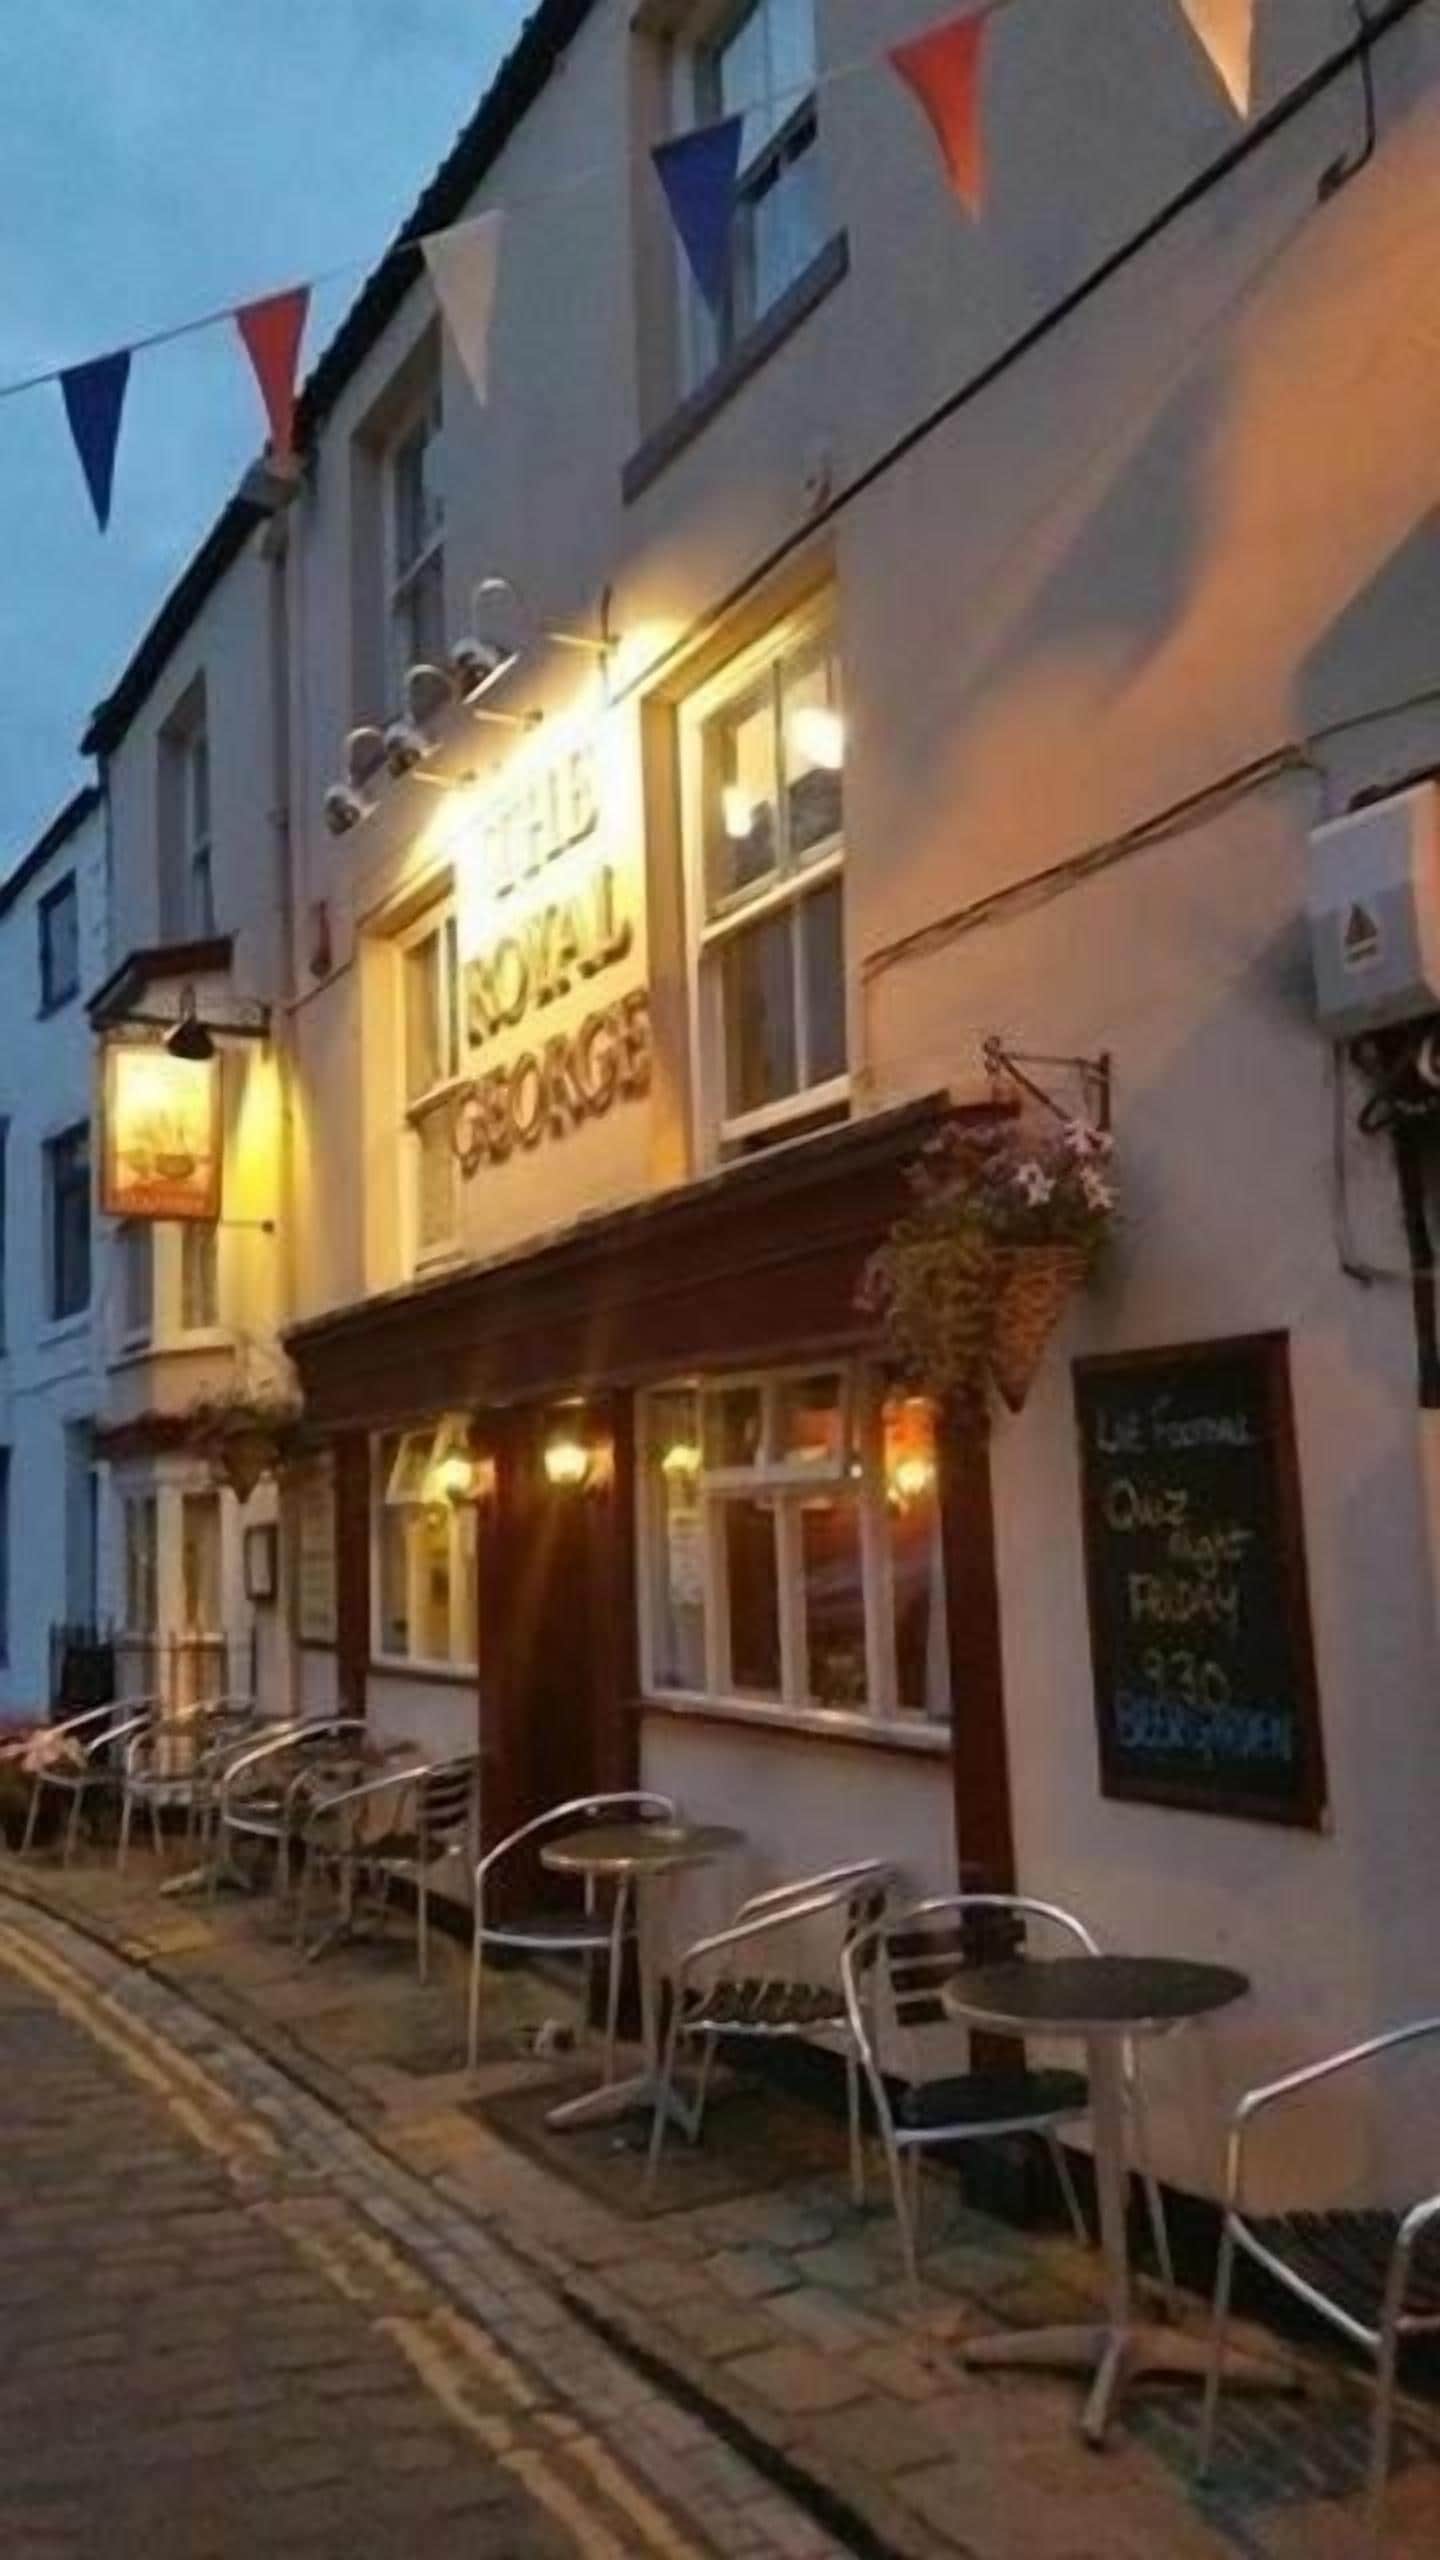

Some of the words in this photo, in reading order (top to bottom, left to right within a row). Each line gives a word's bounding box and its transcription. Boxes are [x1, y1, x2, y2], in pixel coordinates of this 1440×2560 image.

[475, 742, 600, 899] THE
[463, 866, 633, 1048] ROYAL
[451, 989, 653, 1180] GEORGE
